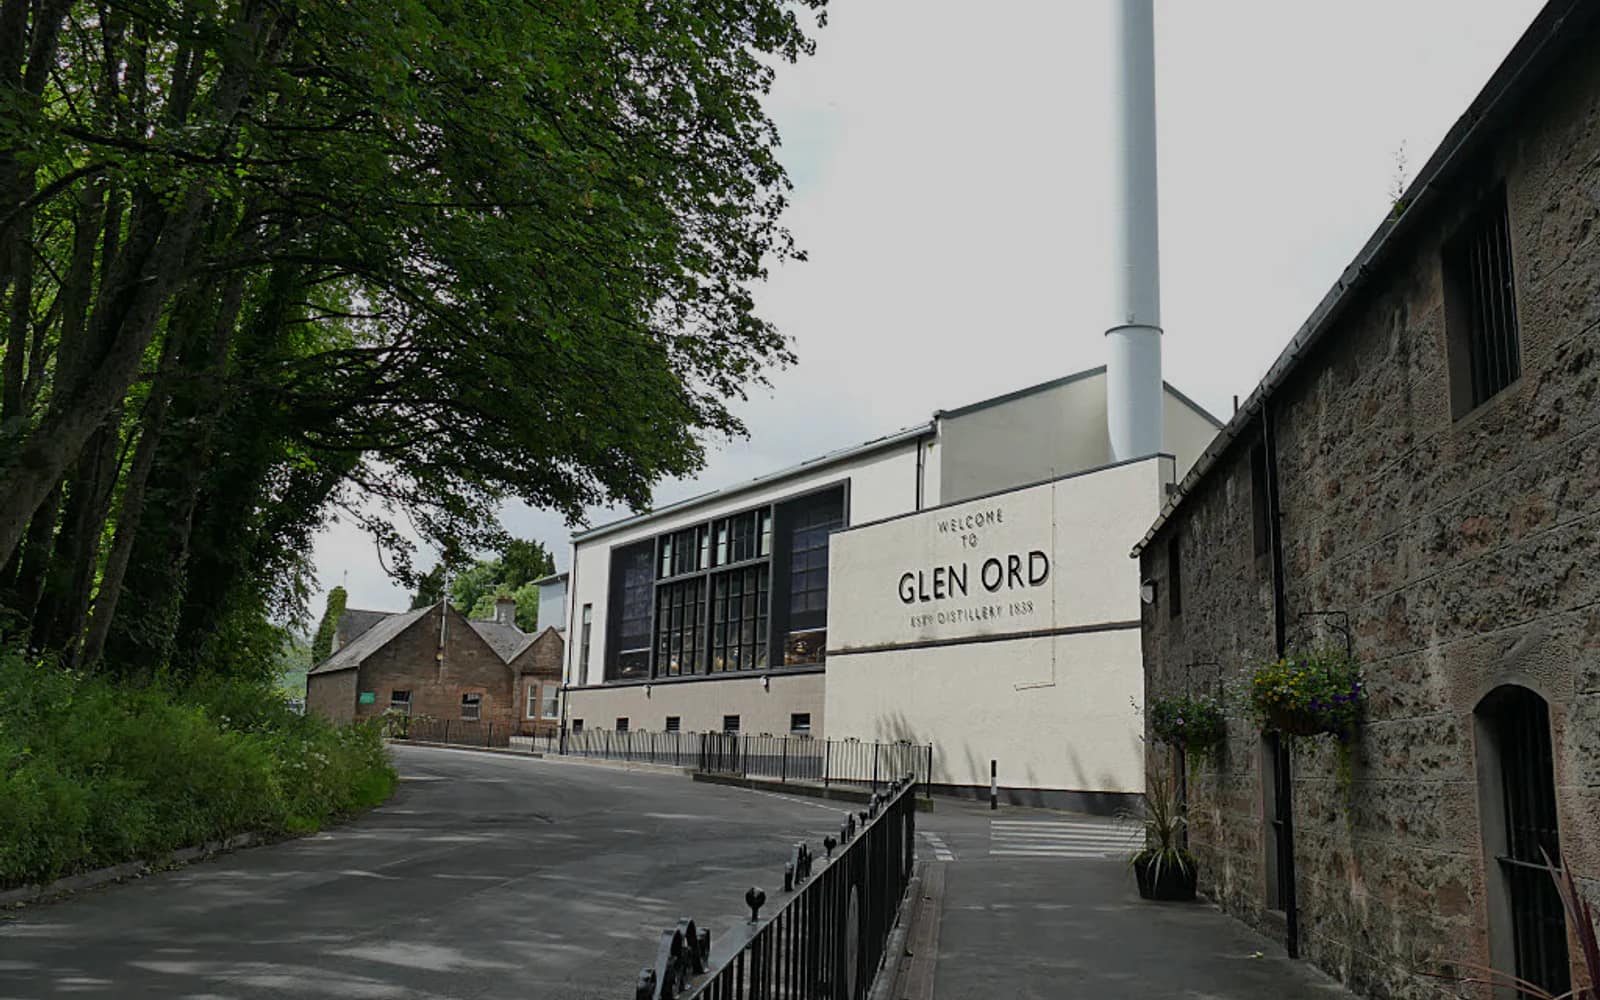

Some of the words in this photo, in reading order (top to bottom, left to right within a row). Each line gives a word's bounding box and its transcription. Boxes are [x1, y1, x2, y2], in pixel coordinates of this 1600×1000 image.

[937, 508, 1004, 534] WELCOME
[961, 533, 978, 548] TO
[898, 562, 968, 604] GLEN
[981, 550, 1050, 592] ORD
[937, 605, 1001, 625] DISTILLERY
[1009, 600, 1034, 616] 1838
